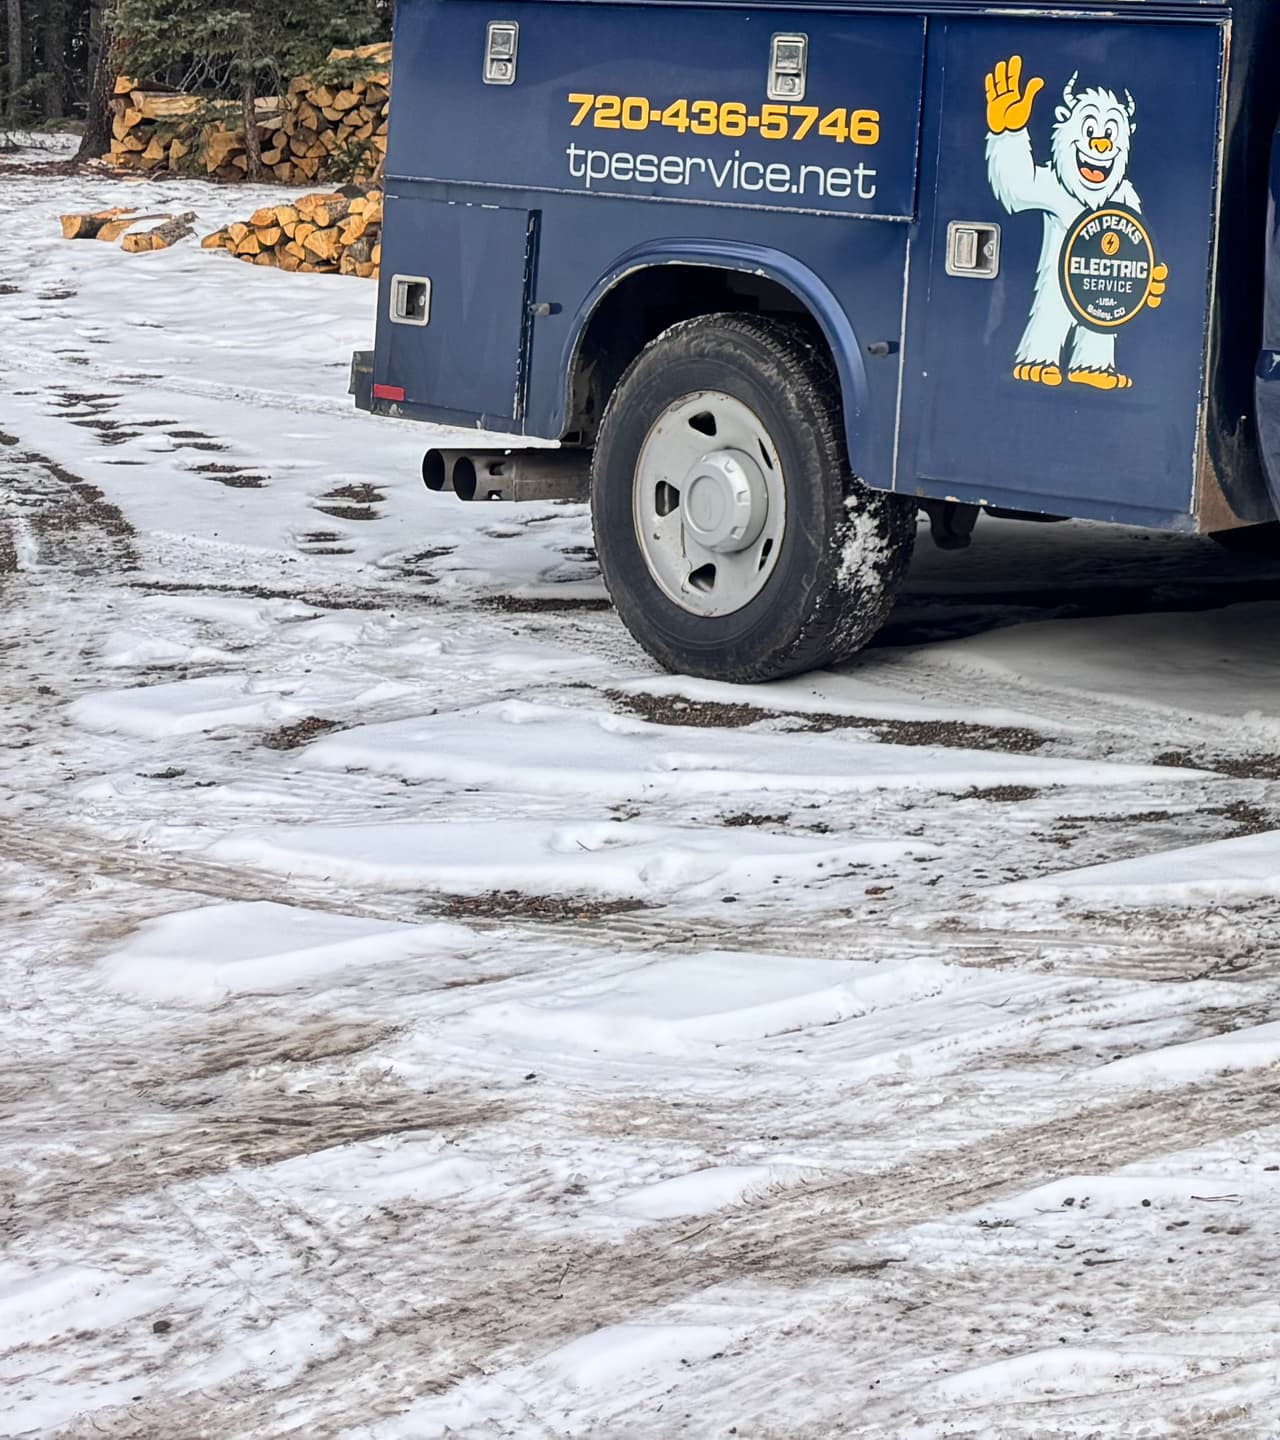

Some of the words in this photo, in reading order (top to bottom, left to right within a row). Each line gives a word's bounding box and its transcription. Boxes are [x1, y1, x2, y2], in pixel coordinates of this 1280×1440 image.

[568, 93, 880, 145] 720-436-5746
[565, 142, 877, 199] tpeservice.net
[1079, 221, 1100, 241] TRI
[1102, 215, 1143, 246] PEAKS
[1070, 257, 1148, 279] ELECTRIC
[1083, 278, 1133, 293] SERVICE
